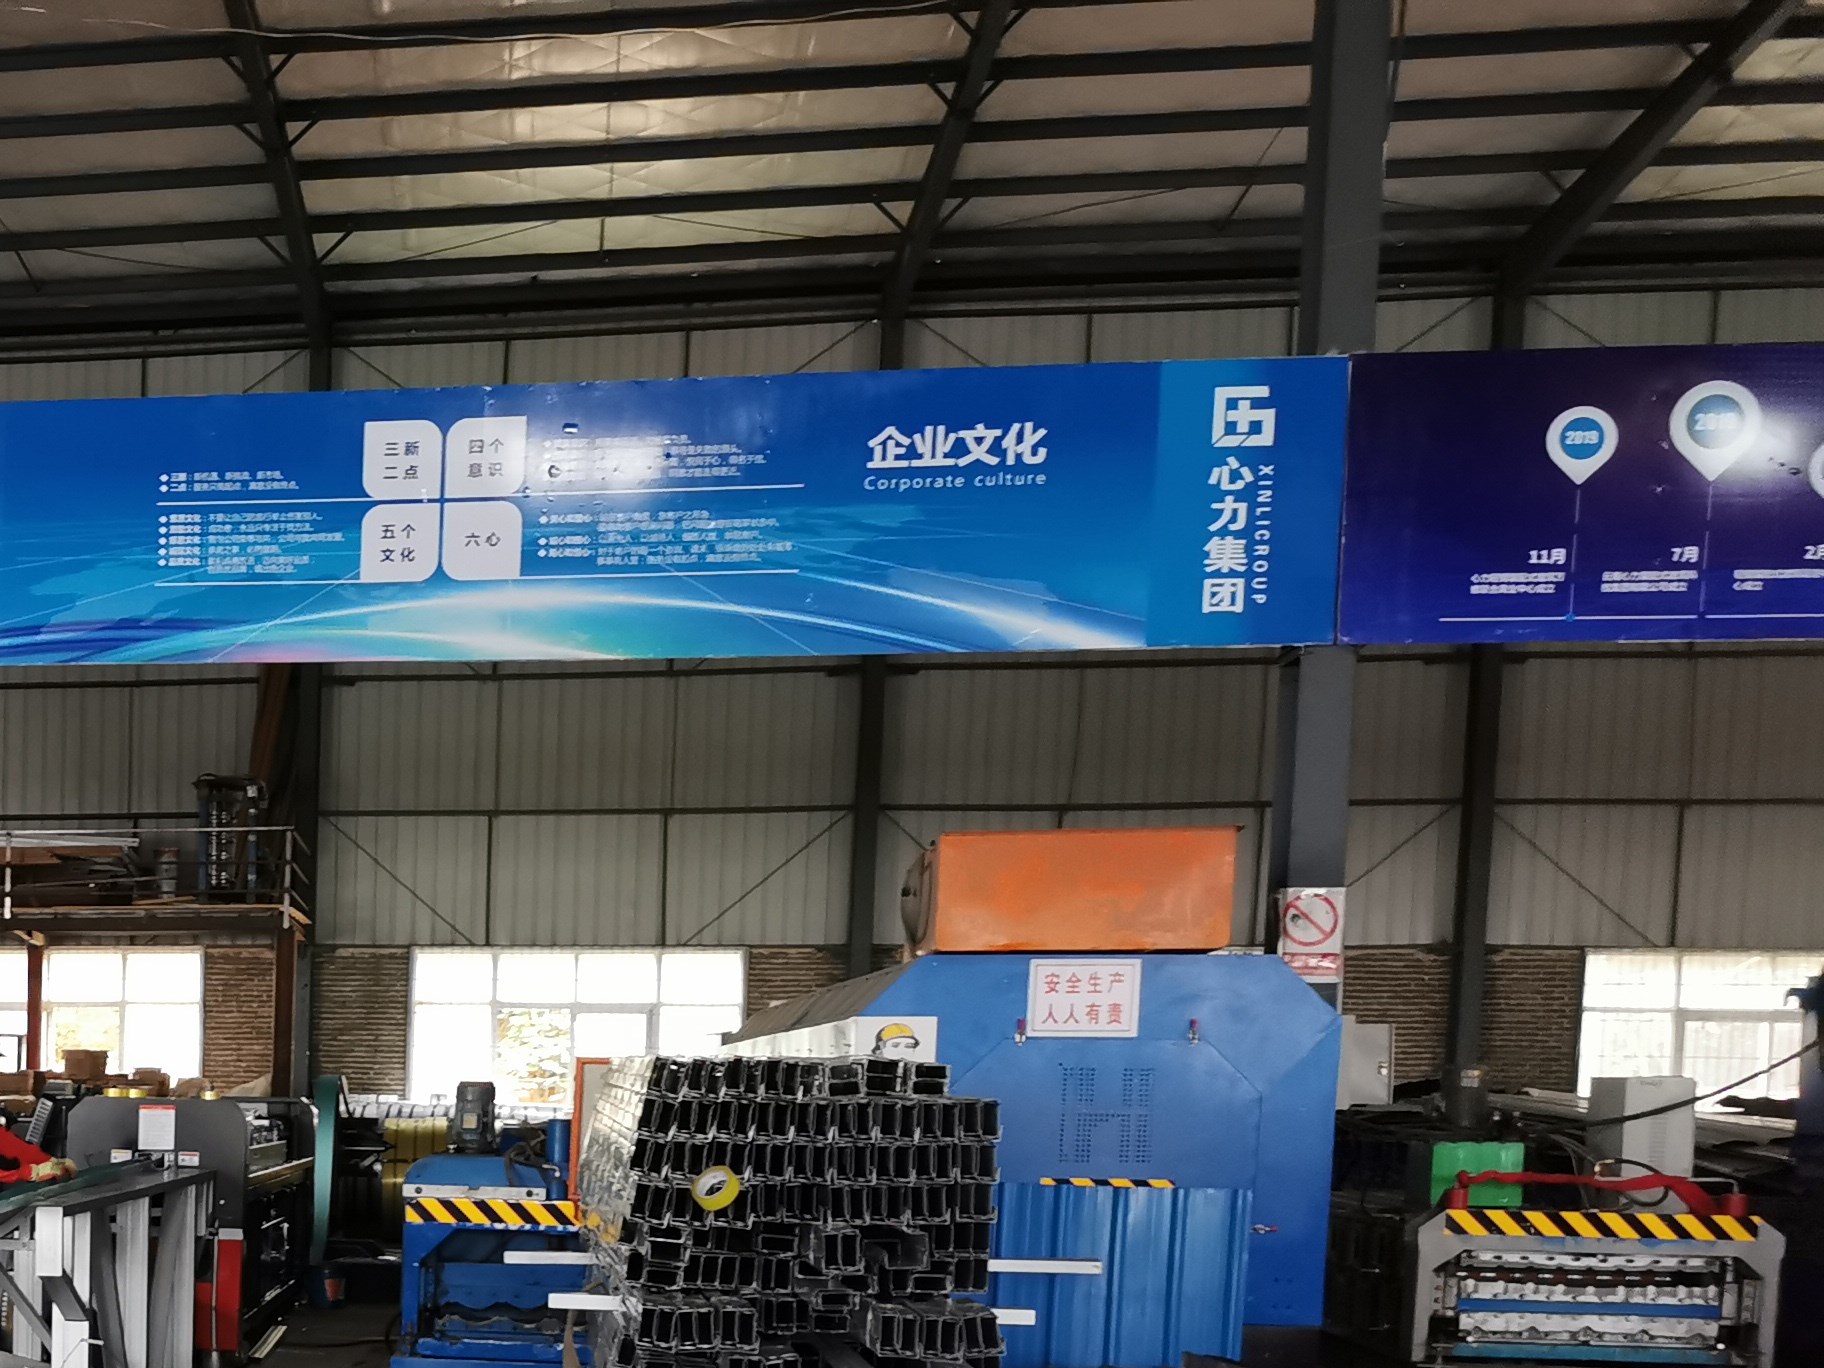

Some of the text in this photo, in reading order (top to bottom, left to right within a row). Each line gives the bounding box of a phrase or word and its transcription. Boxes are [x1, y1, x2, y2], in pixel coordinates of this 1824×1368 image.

[383, 440, 420, 456] 三新
[468, 438, 504, 454] 四个
[866, 421, 1049, 469] 企业文化
[383, 465, 418, 480] 二点
[863, 471, 1047, 493] Corporate culture
[380, 523, 416, 539] 五个
[464, 531, 501, 547] 六心
[1201, 455, 1255, 614] 心力集团
[379, 547, 415, 563] 文化
[1528, 547, 1567, 565] 11月
[1671, 546, 1700, 563] 7月
[1044, 971, 1125, 994] 安全生产
[1041, 1002, 1123, 1025] 人人有责
